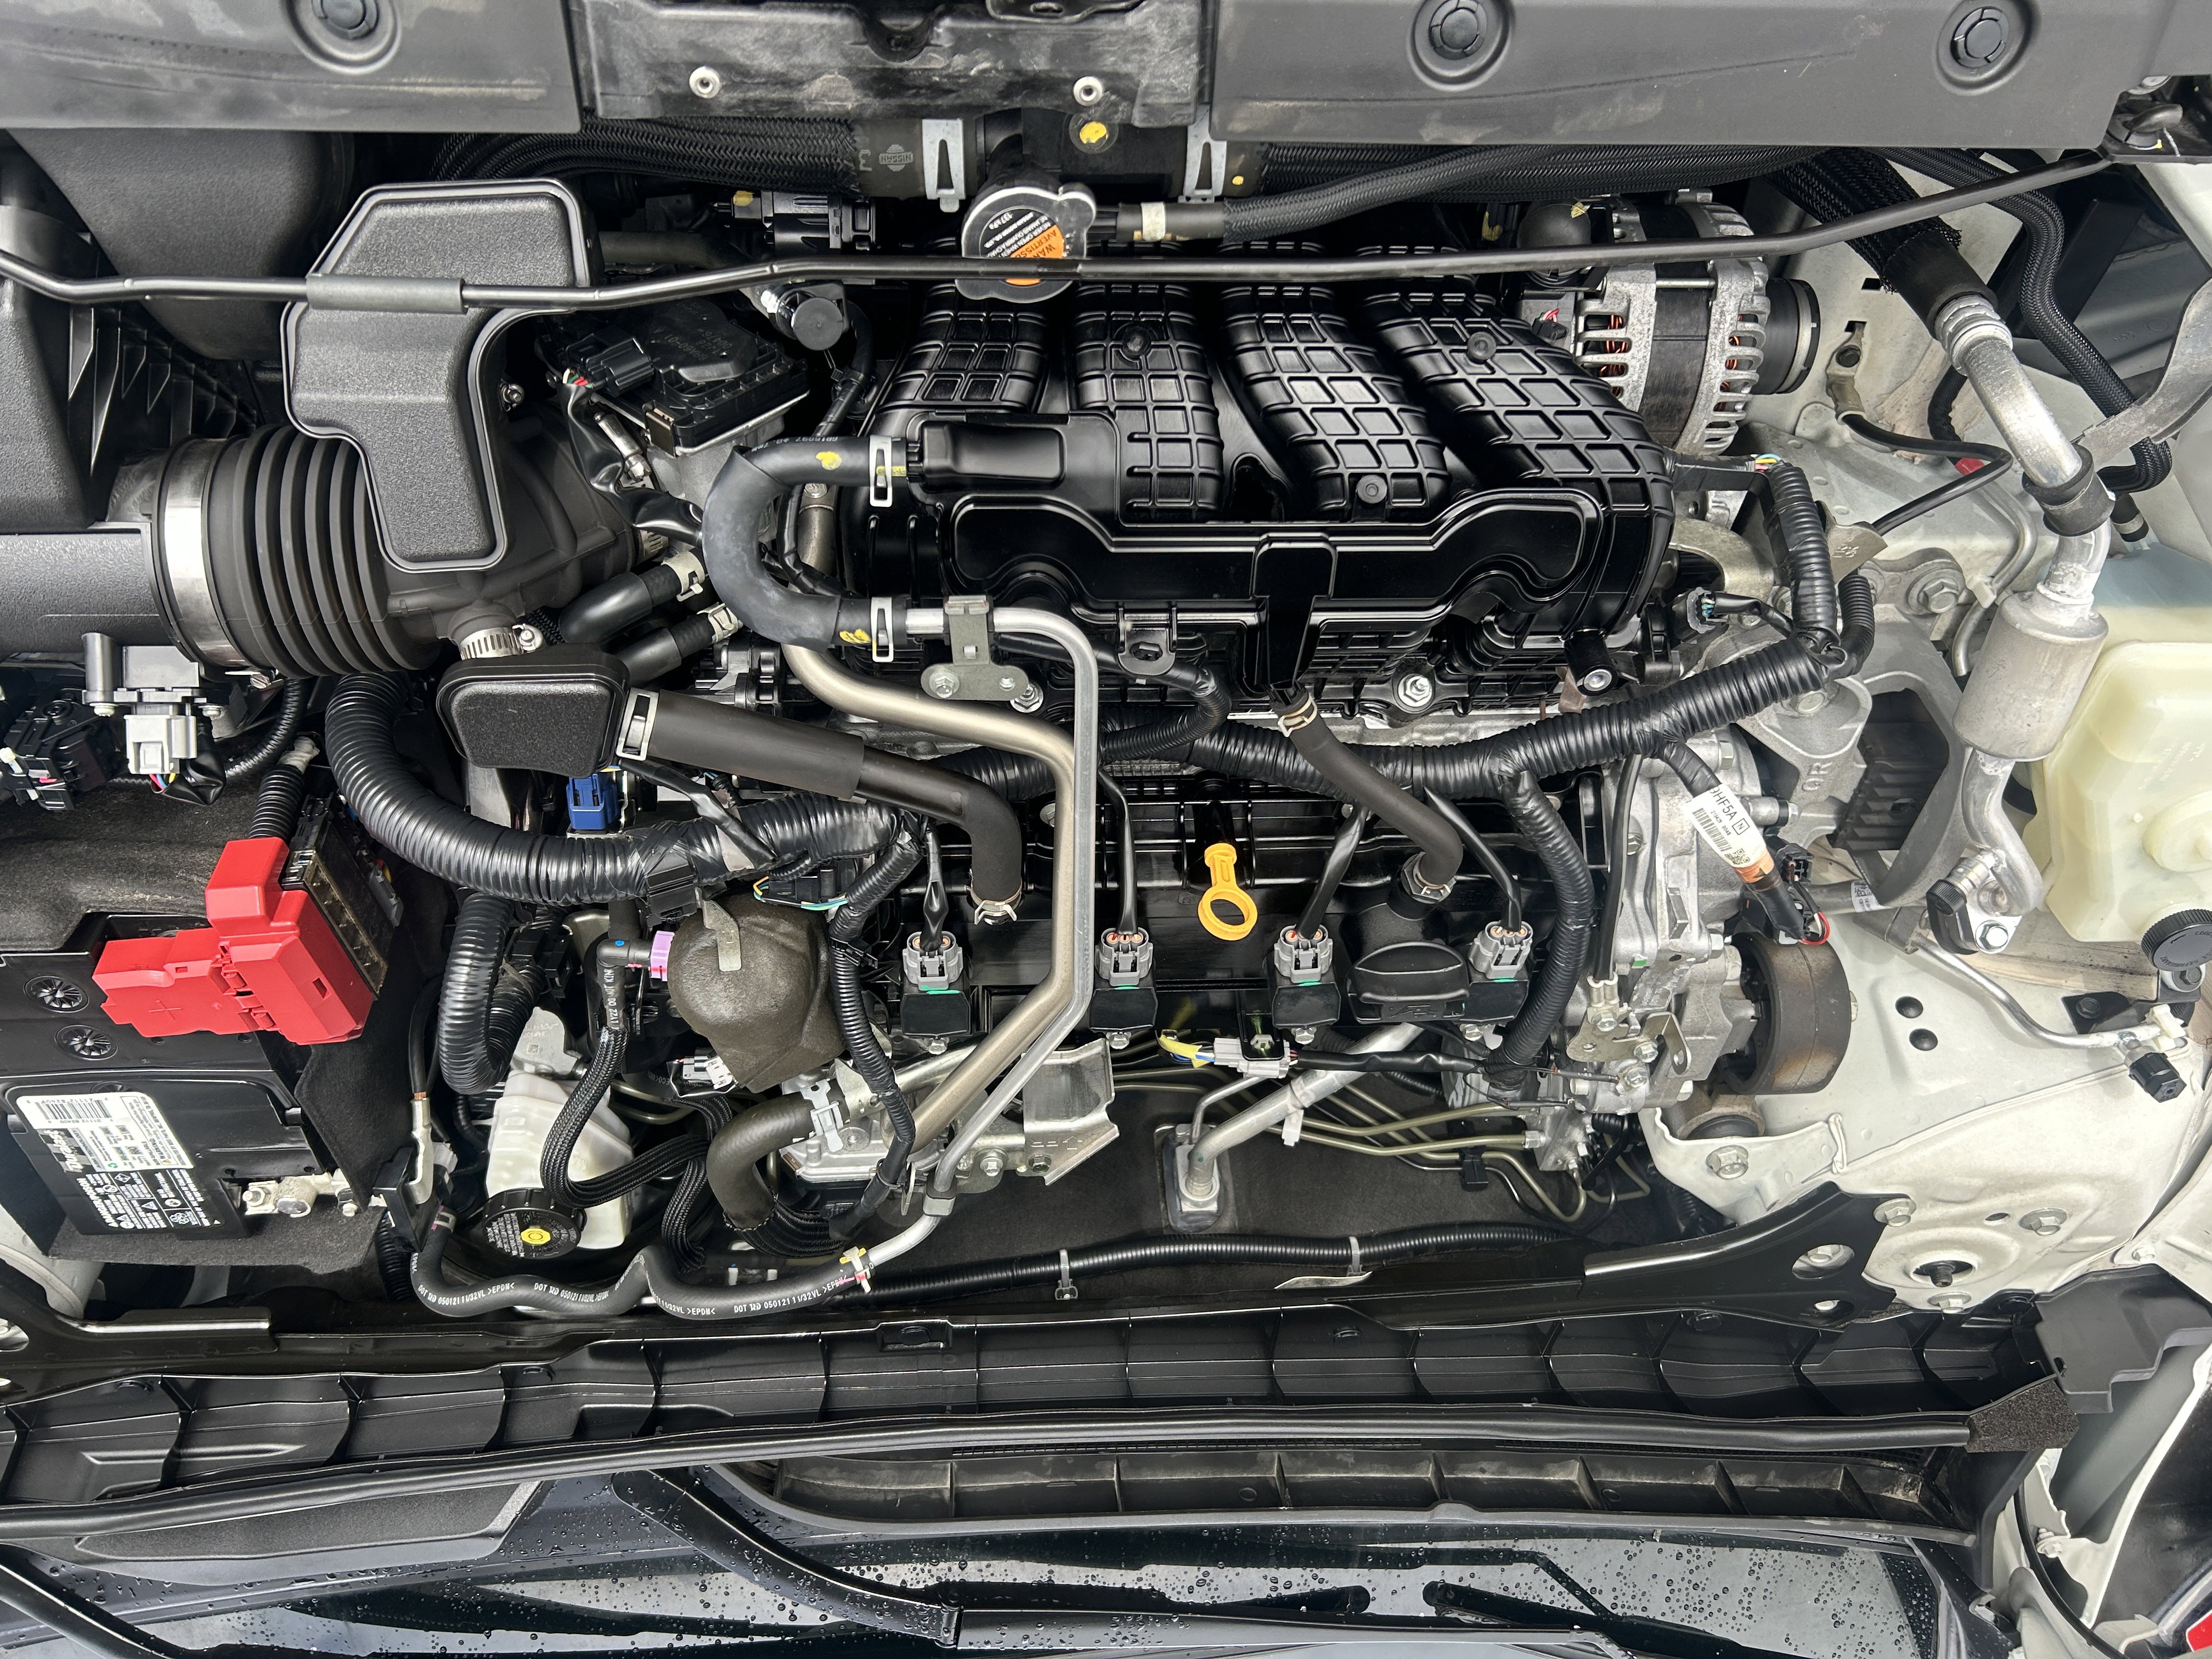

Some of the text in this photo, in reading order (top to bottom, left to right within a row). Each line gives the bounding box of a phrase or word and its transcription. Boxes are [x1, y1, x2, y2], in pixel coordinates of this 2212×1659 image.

[42, 1130, 83, 1170] Duralast
[76, 1178, 115, 1222] DANGER/POISON
[534, 1283, 548, 1291] DOT
[687, 1307, 716, 1316] >EPDM<
[733, 1304, 747, 1313] DOT
